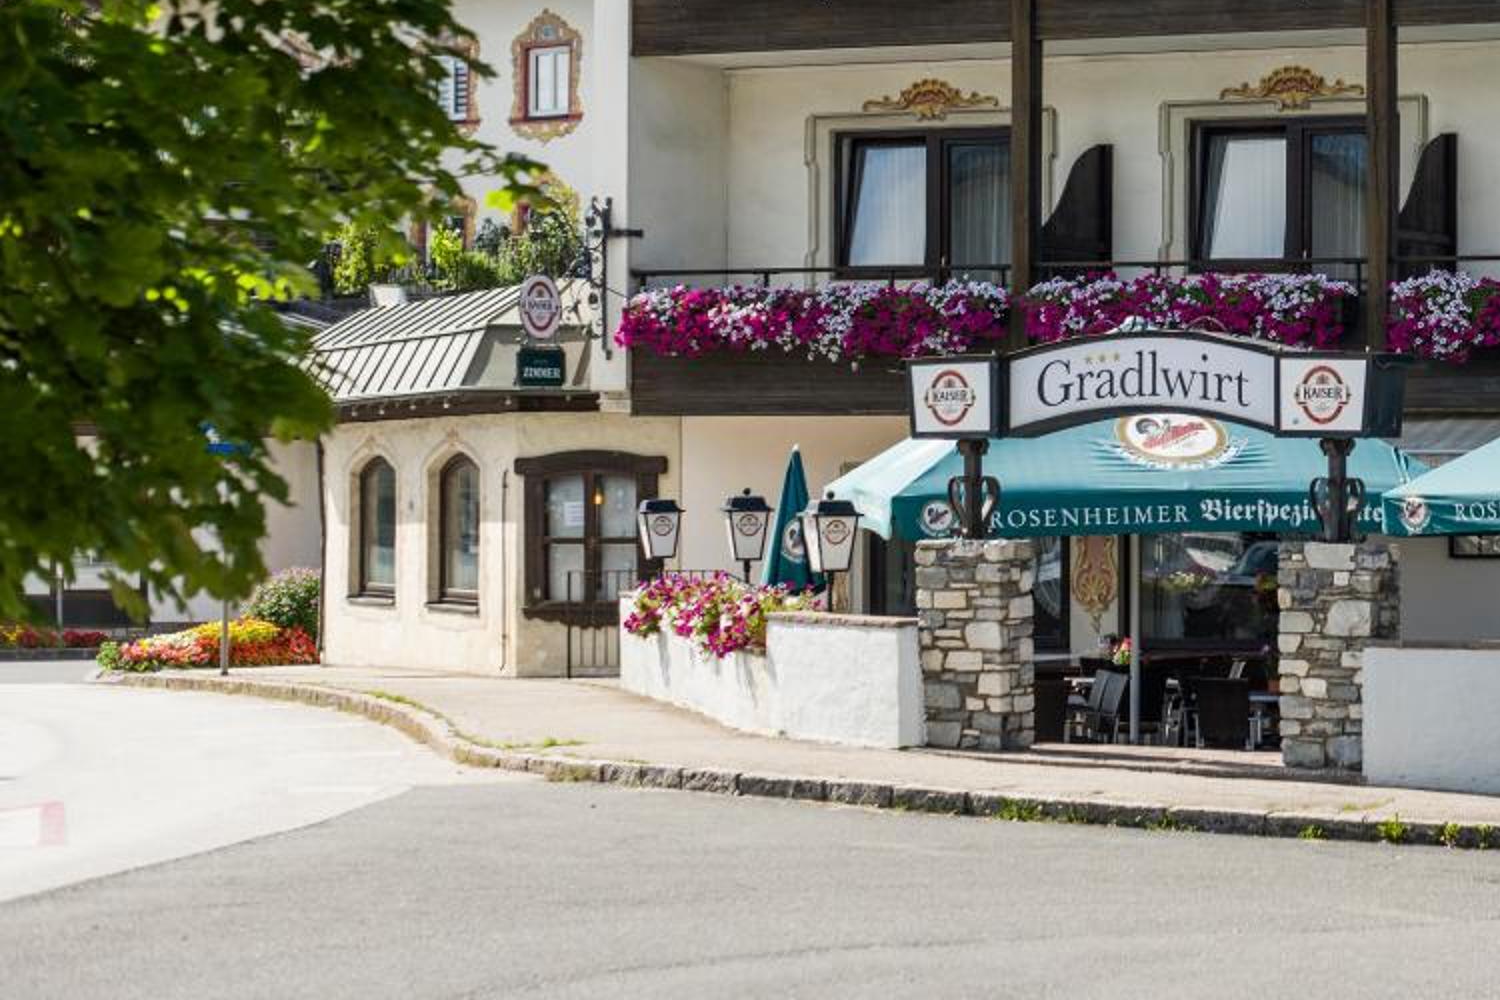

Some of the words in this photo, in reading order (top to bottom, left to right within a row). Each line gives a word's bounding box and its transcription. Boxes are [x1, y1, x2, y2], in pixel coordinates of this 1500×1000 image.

[523, 367, 560, 378] ZIMMER
[1037, 351, 1251, 407] Gradlwirt
[1303, 386, 1343, 399] KAISER
[991, 504, 1190, 529] ROSENHEIMER
